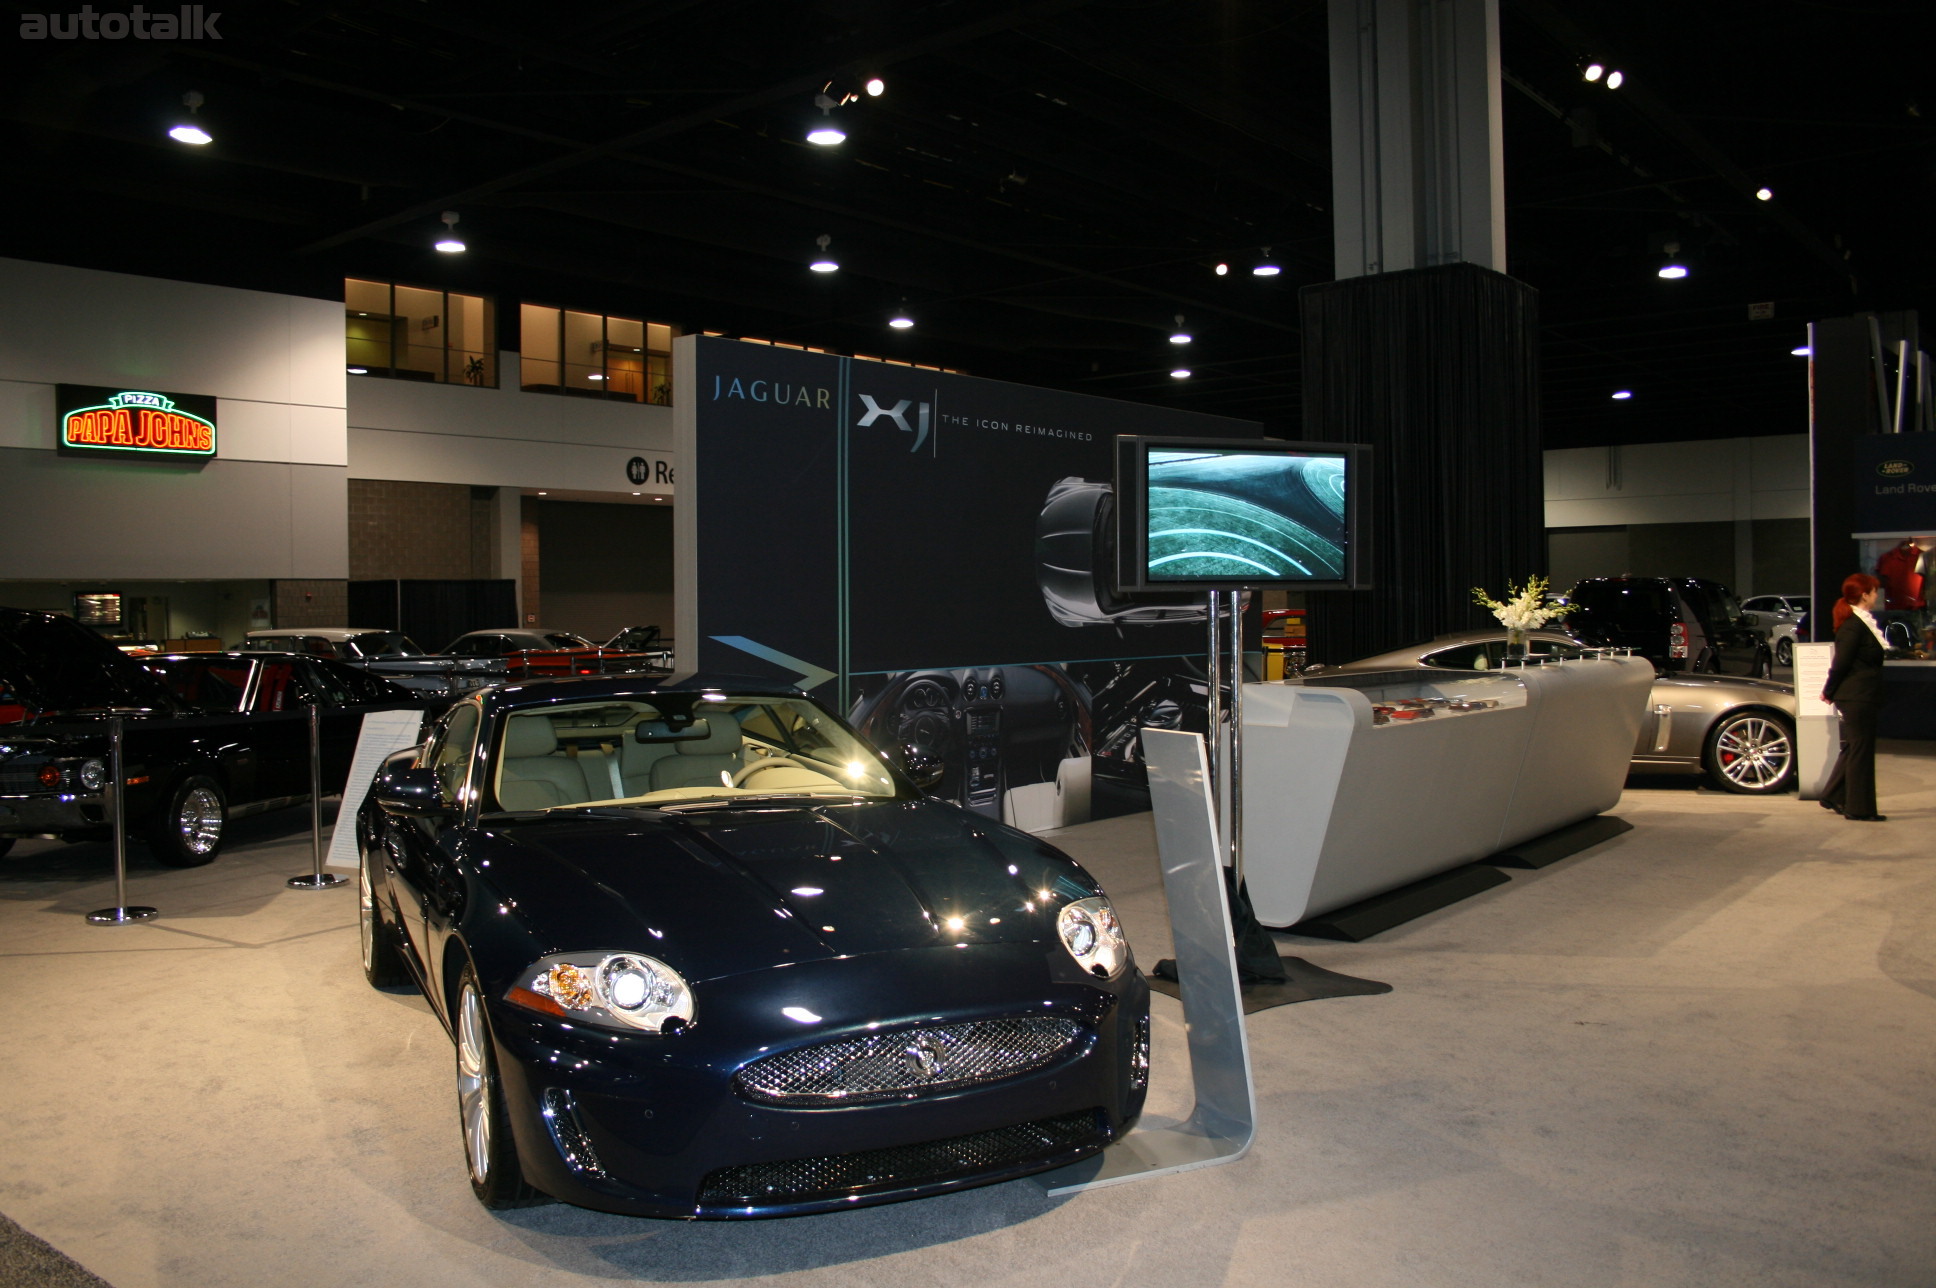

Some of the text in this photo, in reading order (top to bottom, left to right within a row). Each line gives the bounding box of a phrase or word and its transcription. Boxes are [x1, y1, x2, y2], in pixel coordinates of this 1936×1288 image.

[124, 394, 160, 406] PIZZA
[713, 375, 830, 409] JAGUAR
[68, 409, 133, 444] PAPA
[856, 393, 930, 452] XJ
[942, 414, 1093, 442] THE ICON REIMAGINED
[1875, 484, 1904, 495] Land
